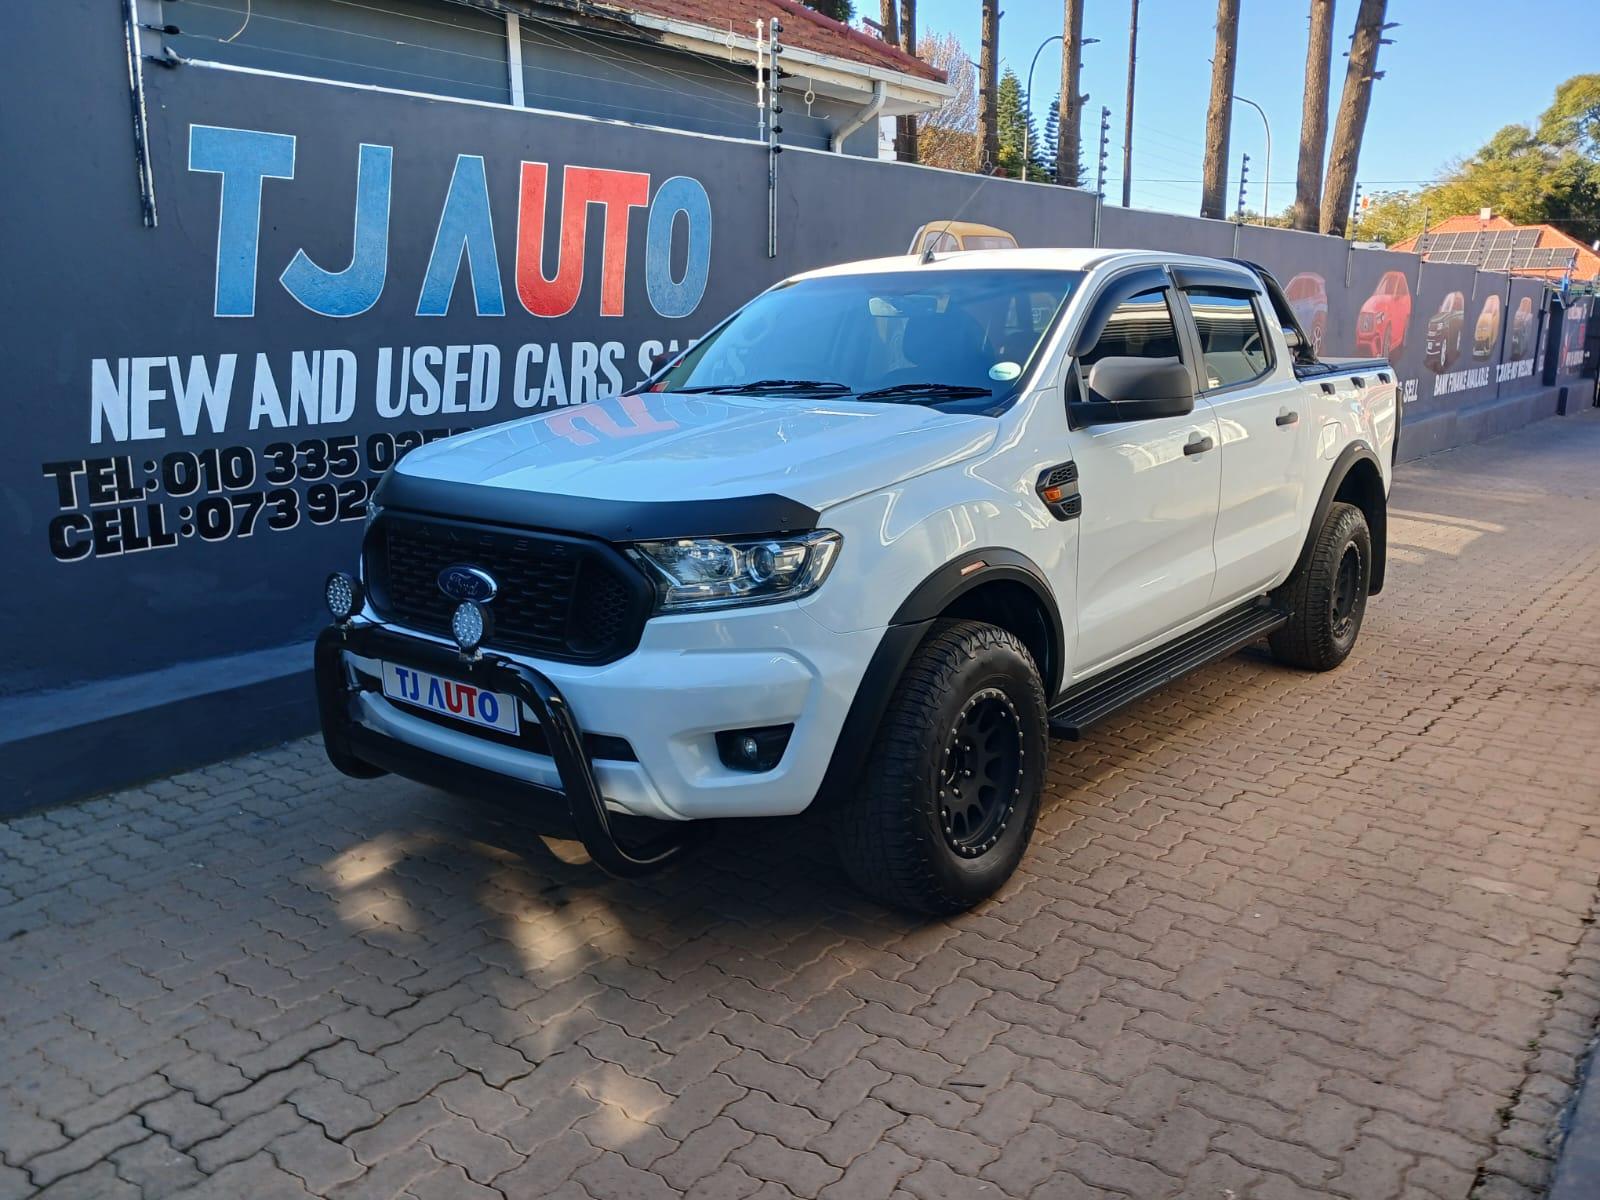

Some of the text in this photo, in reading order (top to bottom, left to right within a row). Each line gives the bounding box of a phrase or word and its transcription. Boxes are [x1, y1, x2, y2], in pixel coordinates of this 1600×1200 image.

[188, 123, 713, 318] TJ AUTO
[90, 353, 238, 443] NEW
[248, 348, 357, 430] AND
[375, 344, 501, 418] USED
[513, 341, 626, 409] CARS
[1403, 378, 1419, 403] SELL
[264, 435, 360, 486] 335
[395, 666, 499, 723] TJ AUTO
